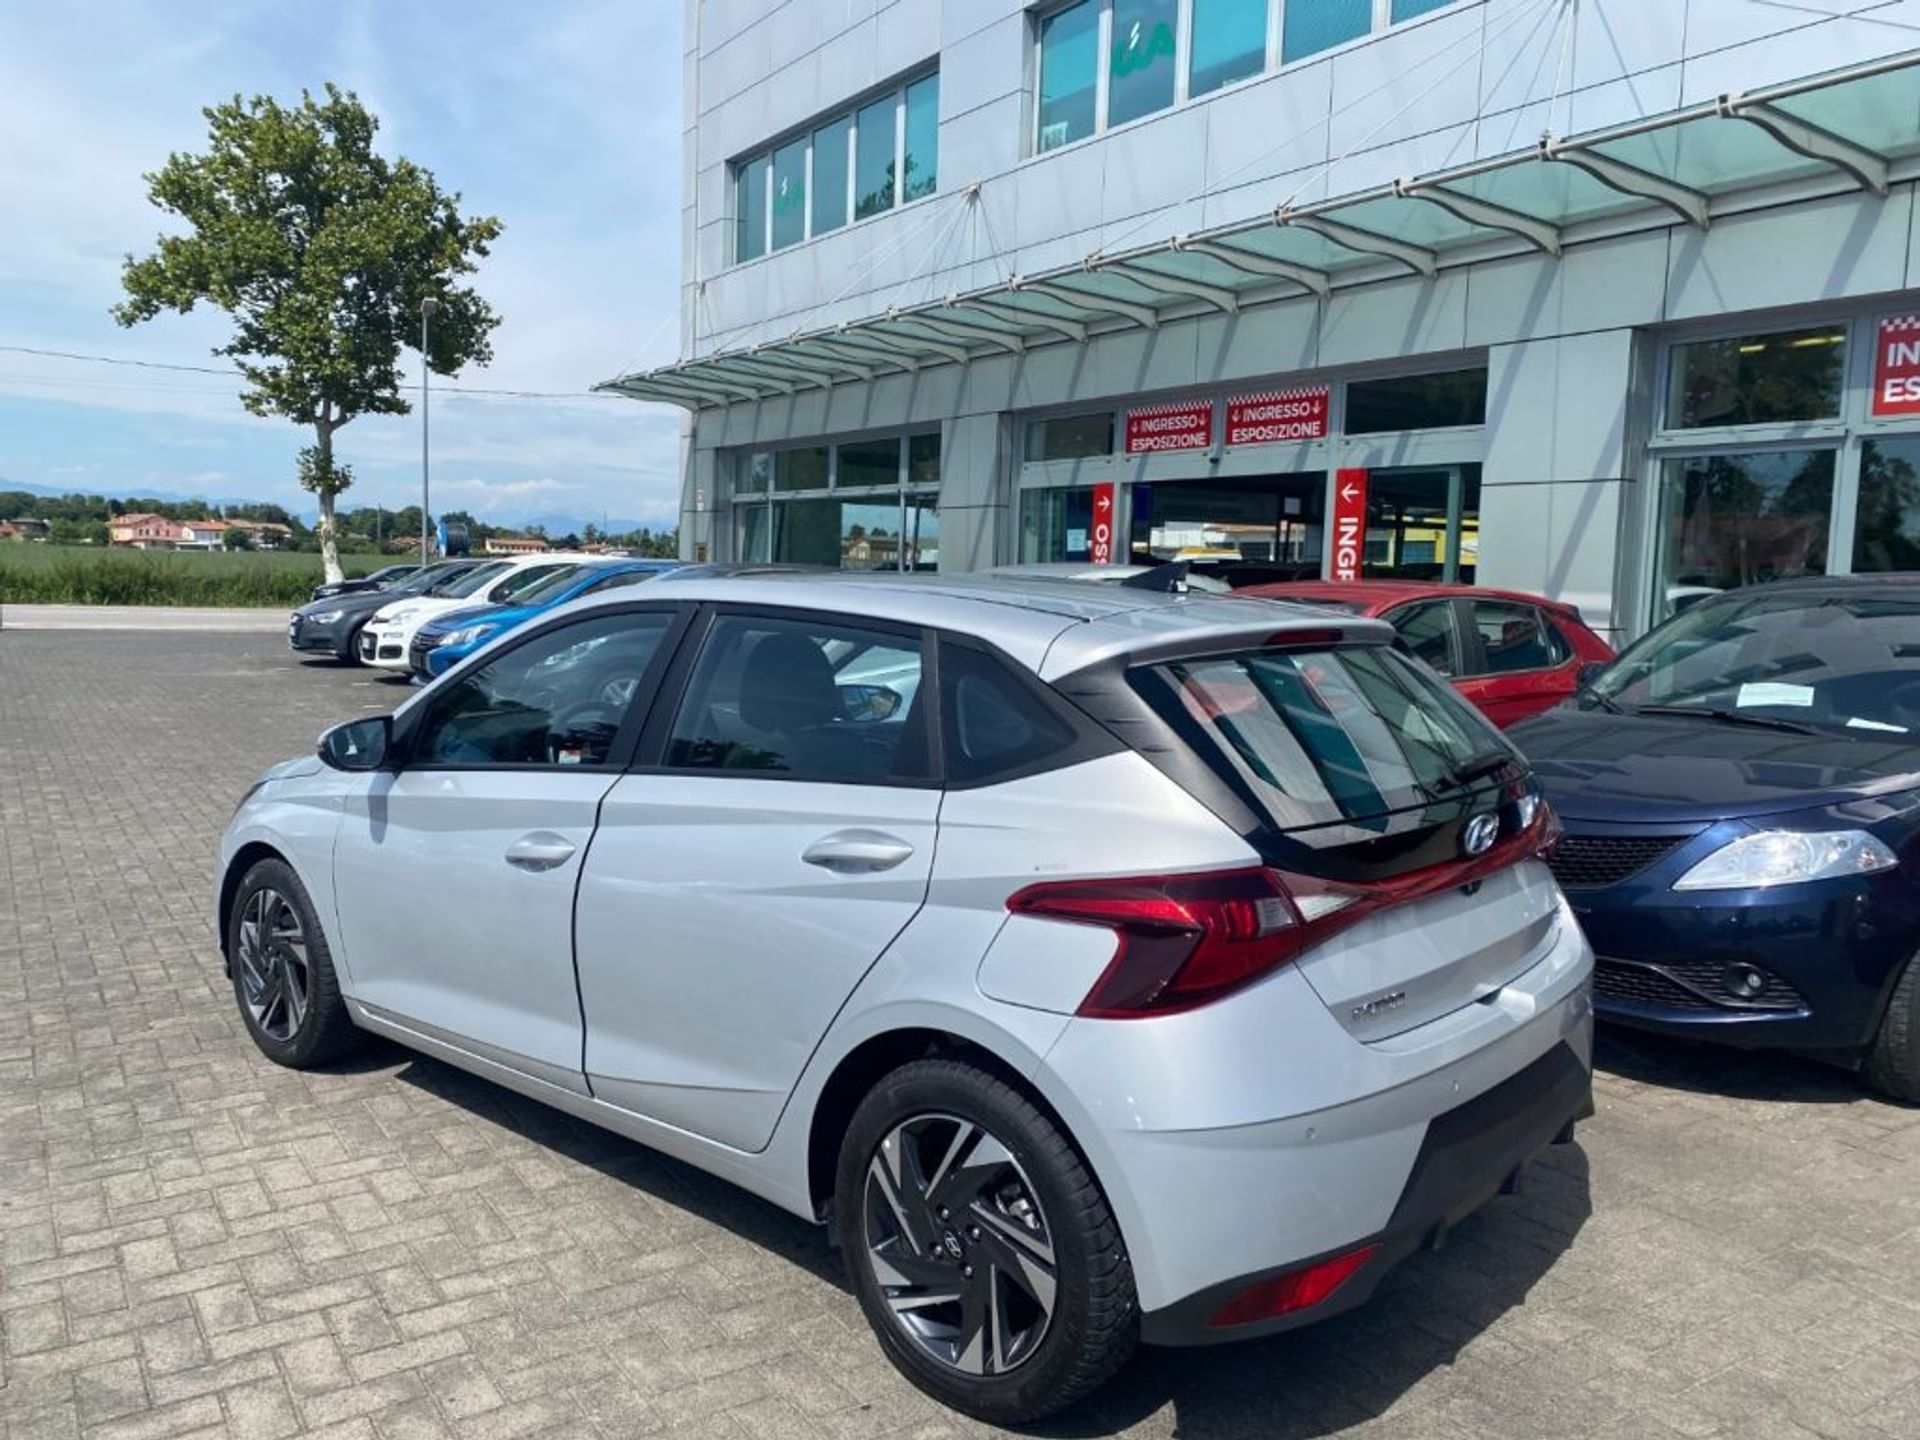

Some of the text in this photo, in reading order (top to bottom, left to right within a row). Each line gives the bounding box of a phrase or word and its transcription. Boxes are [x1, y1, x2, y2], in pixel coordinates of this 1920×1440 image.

[1243, 402, 1311, 423] INGRESSO
[1141, 414, 1197, 433] INGRESSO
[1231, 421, 1320, 442] ESPOSIZIONE
[1131, 433, 1207, 451] ESPOSIZIONE
